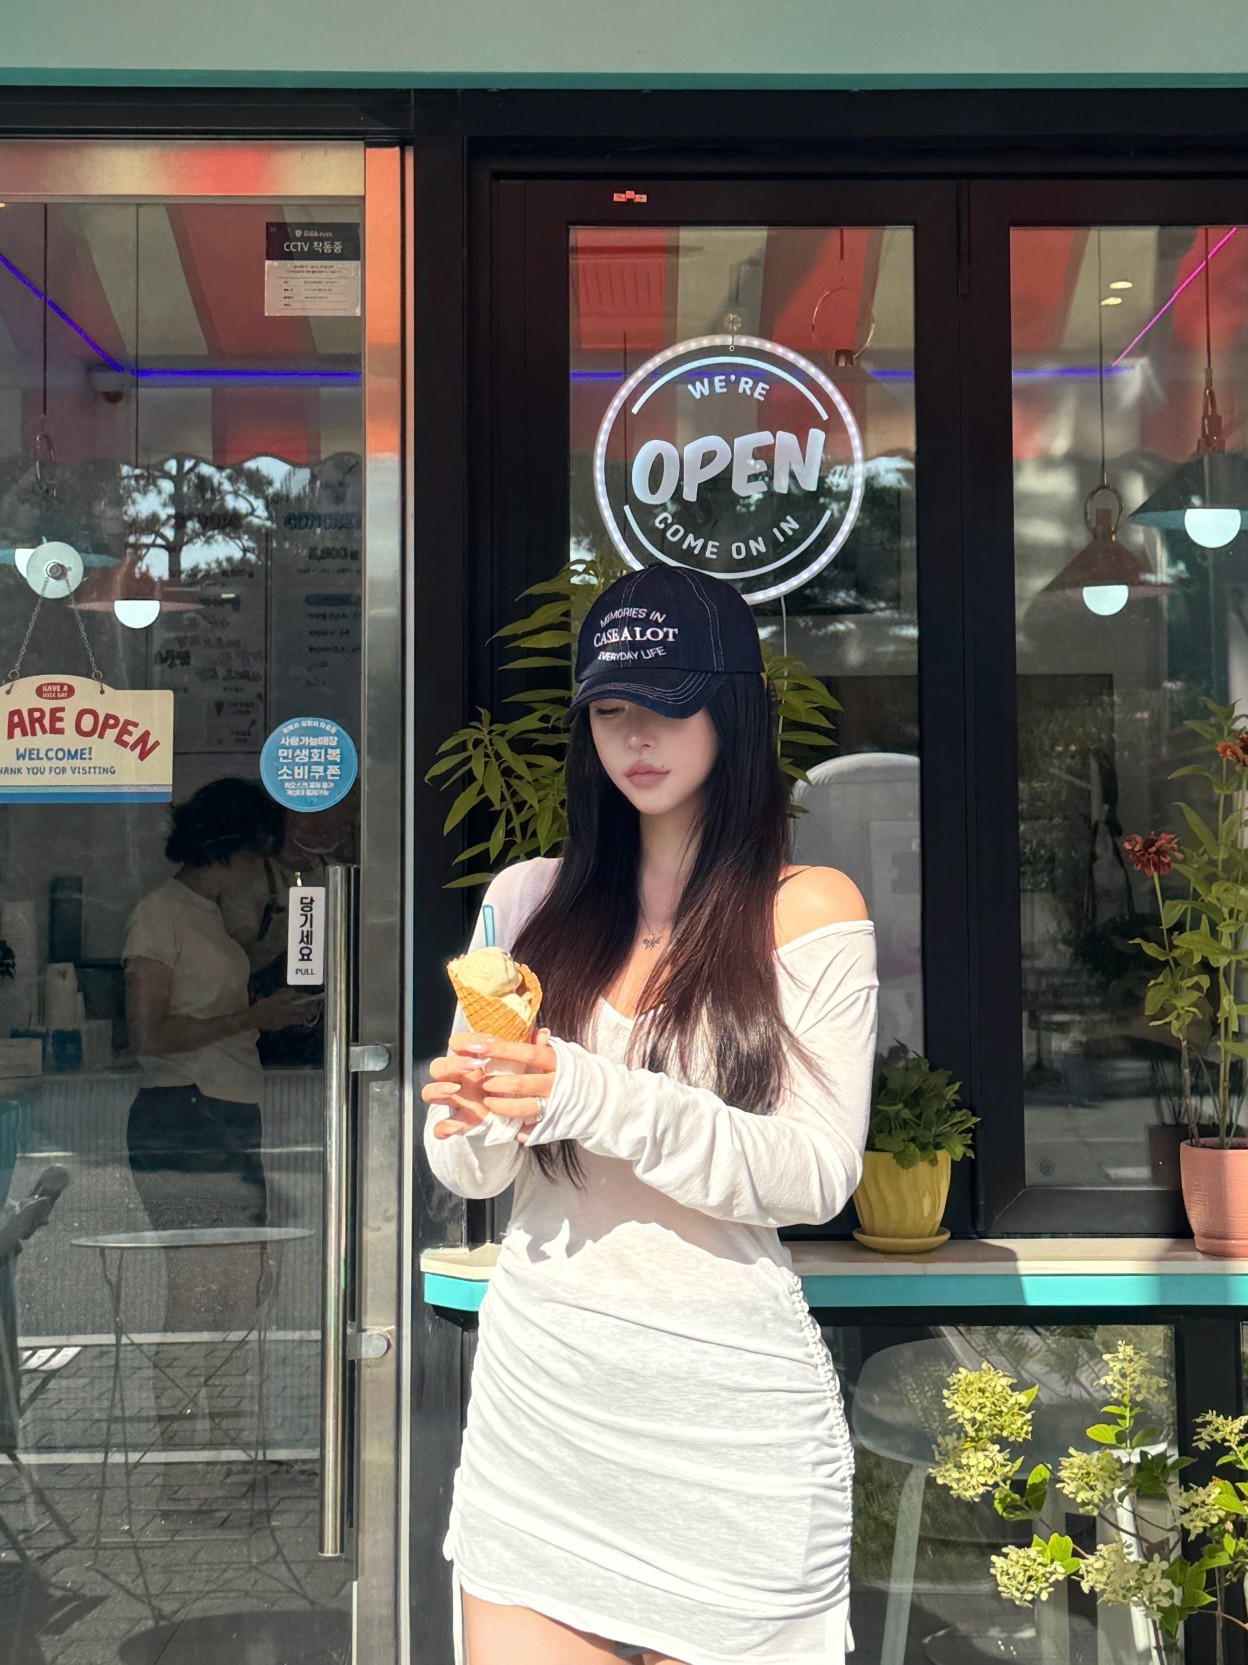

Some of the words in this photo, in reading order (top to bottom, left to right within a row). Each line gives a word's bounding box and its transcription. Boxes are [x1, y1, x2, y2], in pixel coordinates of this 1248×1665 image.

[283, 241, 309, 252] CCTV
[313, 241, 343, 253] 작동중
[631, 428, 826, 505] OPEN
[654, 512, 720, 559] COME
[731, 536, 767, 560] ON
[772, 515, 800, 543] IN
[600, 607, 648, 628] MEMORIES
[649, 610, 666, 623] IN
[597, 650, 639, 661] EVERYDAY
[640, 646, 667, 660] LIFE
[7, 706, 66, 740] ARE
[74, 707, 161, 762] OPEN
[15, 747, 93, 761] WELCOME!
[278, 748, 341, 763] 민생회복
[26, 766, 46, 775] YOU
[48, 766, 67, 775] FOR
[70, 766, 116, 775] VISITING
[278, 765, 341, 780] 소비쿠폰
[298, 895, 315, 962] 당기세요
[294, 968, 315, 976] PULL
